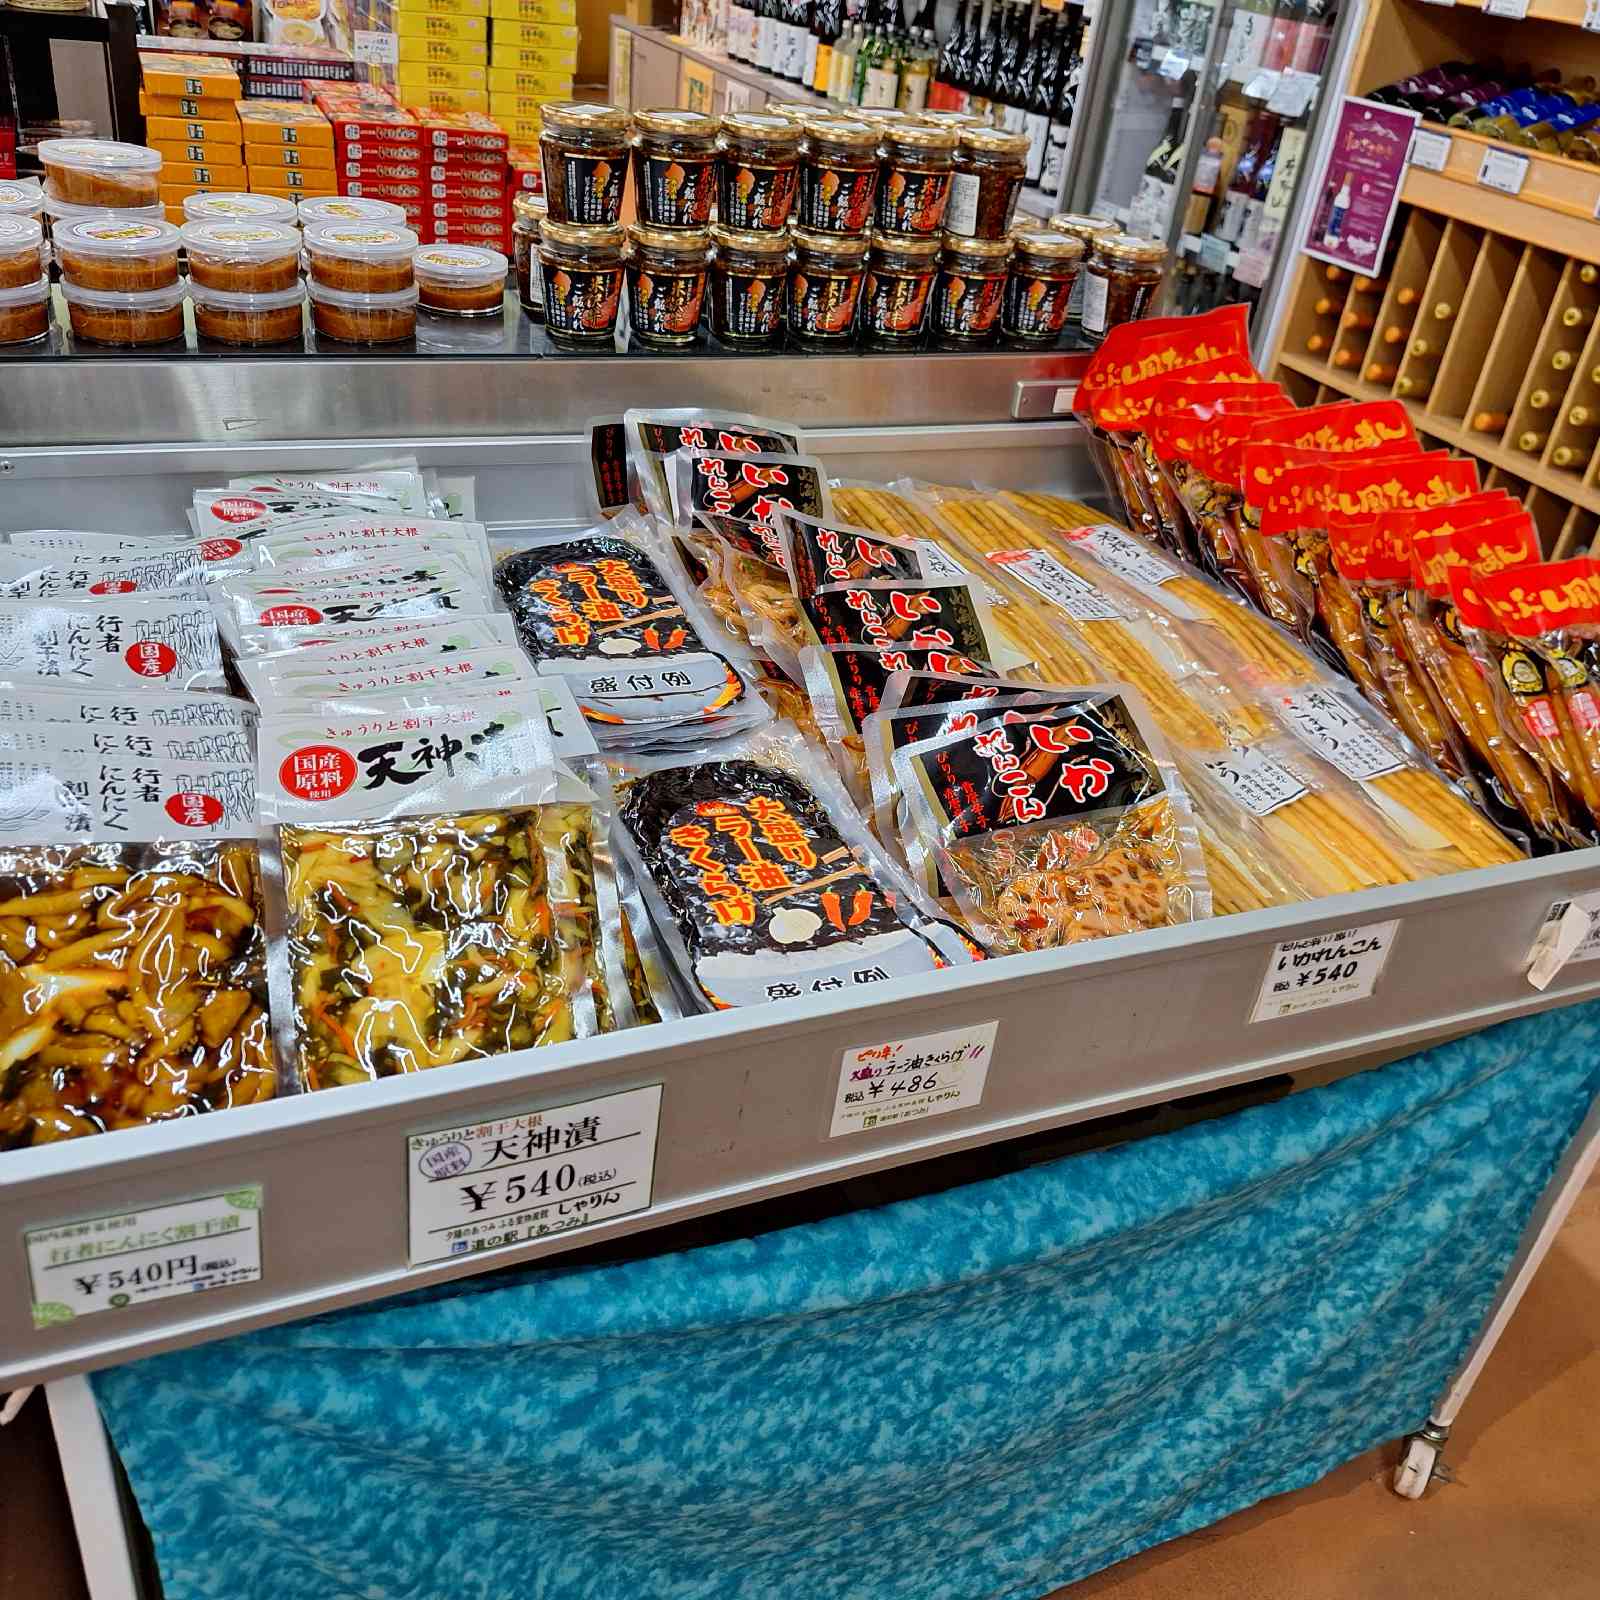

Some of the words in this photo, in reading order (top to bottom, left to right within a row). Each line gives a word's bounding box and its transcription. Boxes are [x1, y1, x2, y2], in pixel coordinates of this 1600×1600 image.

[567, 571, 625, 622] ラー油
[66, 614, 94, 678] にんにく
[95, 614, 124, 653] 行者
[140, 643, 163, 675] 国産
[590, 670, 692, 694] 盛付例
[293, 752, 341, 772] 国産
[972, 728, 1047, 824] れんこん
[1029, 724, 1115, 804] いか
[99, 764, 129, 831] にんにく
[132, 767, 163, 803] 行者
[294, 772, 343, 790] 原料
[182, 793, 209, 825] 国産
[746, 795, 818, 869] 大盛り
[714, 815, 792, 892] ラー油
[669, 824, 757, 927] きくらげ
[1276, 937, 1383, 971] いかれんこん
[1295, 961, 1359, 987] ¥540
[868, 1071, 939, 1099] ¥486
[411, 1113, 544, 1151] きゅうりと割干大根
[481, 1115, 601, 1168] 天神漬
[558, 1191, 621, 1216] しゃりん
[470, 1231, 519, 1251] 道の駅
